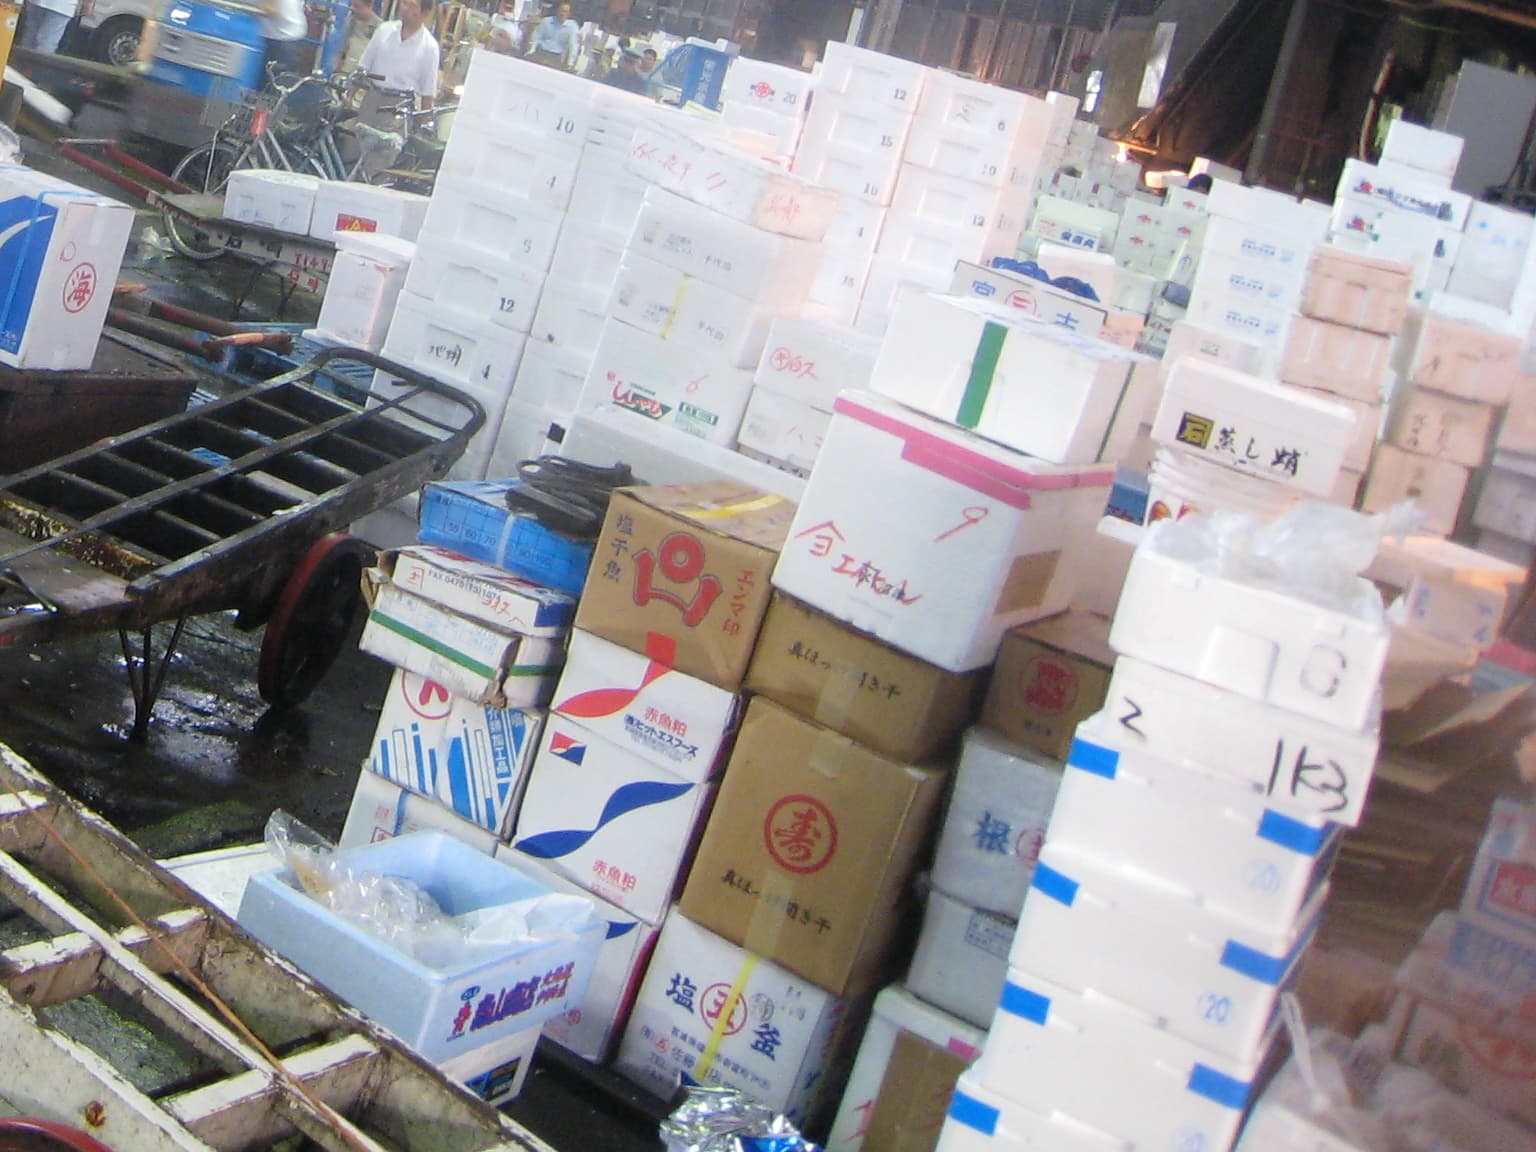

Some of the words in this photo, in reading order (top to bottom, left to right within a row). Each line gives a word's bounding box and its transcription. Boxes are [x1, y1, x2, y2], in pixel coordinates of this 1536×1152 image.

[554, 117, 575, 134] 10
[67, 270, 92, 307] 海
[498, 296, 515, 314] 12
[603, 514, 633, 583] 塩干魚
[592, 858, 637, 892] 赤魚粕
[665, 973, 698, 1014] 塩
[750, 1023, 782, 1062] 釜
